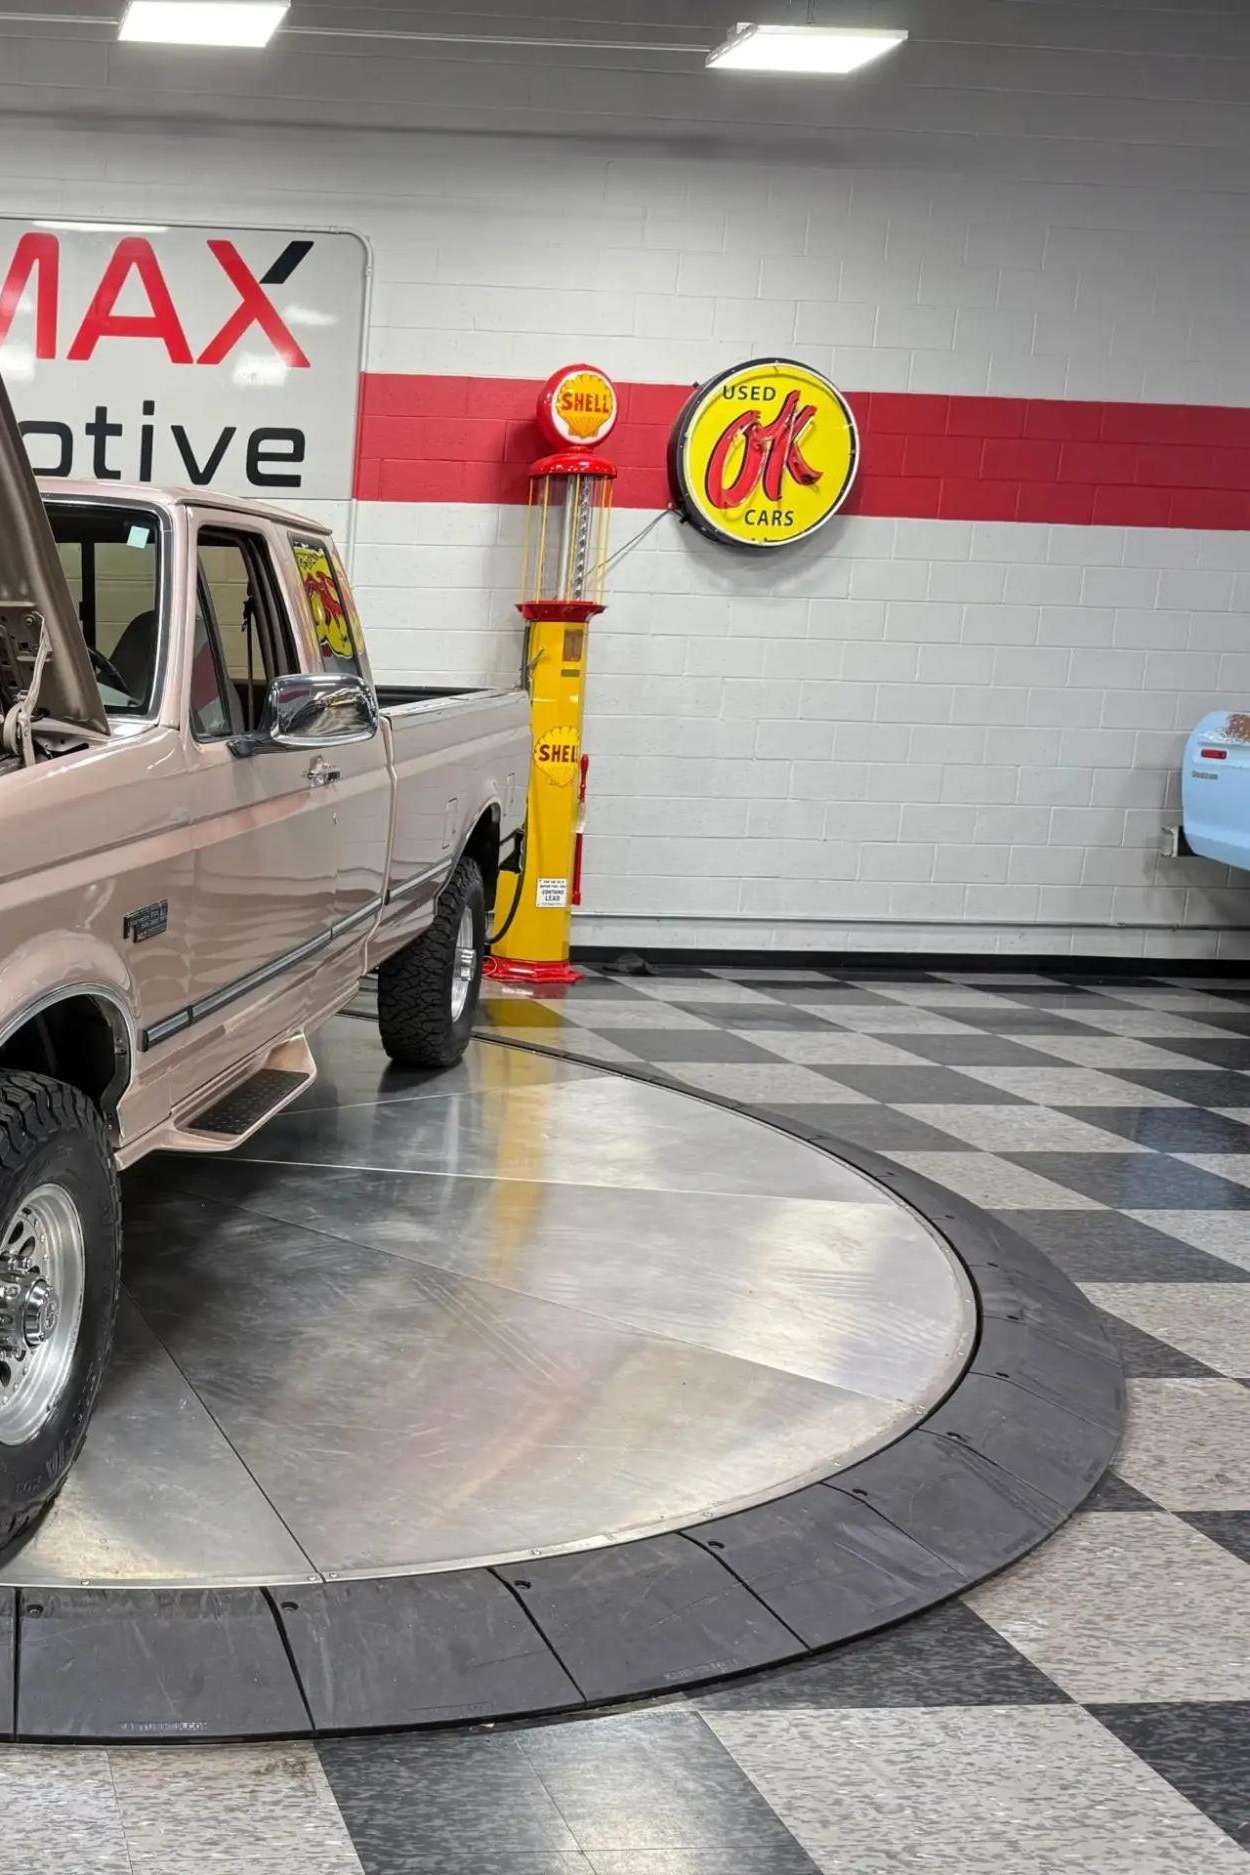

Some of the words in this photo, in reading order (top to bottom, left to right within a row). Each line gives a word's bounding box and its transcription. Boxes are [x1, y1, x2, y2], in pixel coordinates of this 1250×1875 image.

[722, 384, 777, 402] USED
[561, 391, 612, 415] SHELL
[744, 509, 795, 527] CARS
